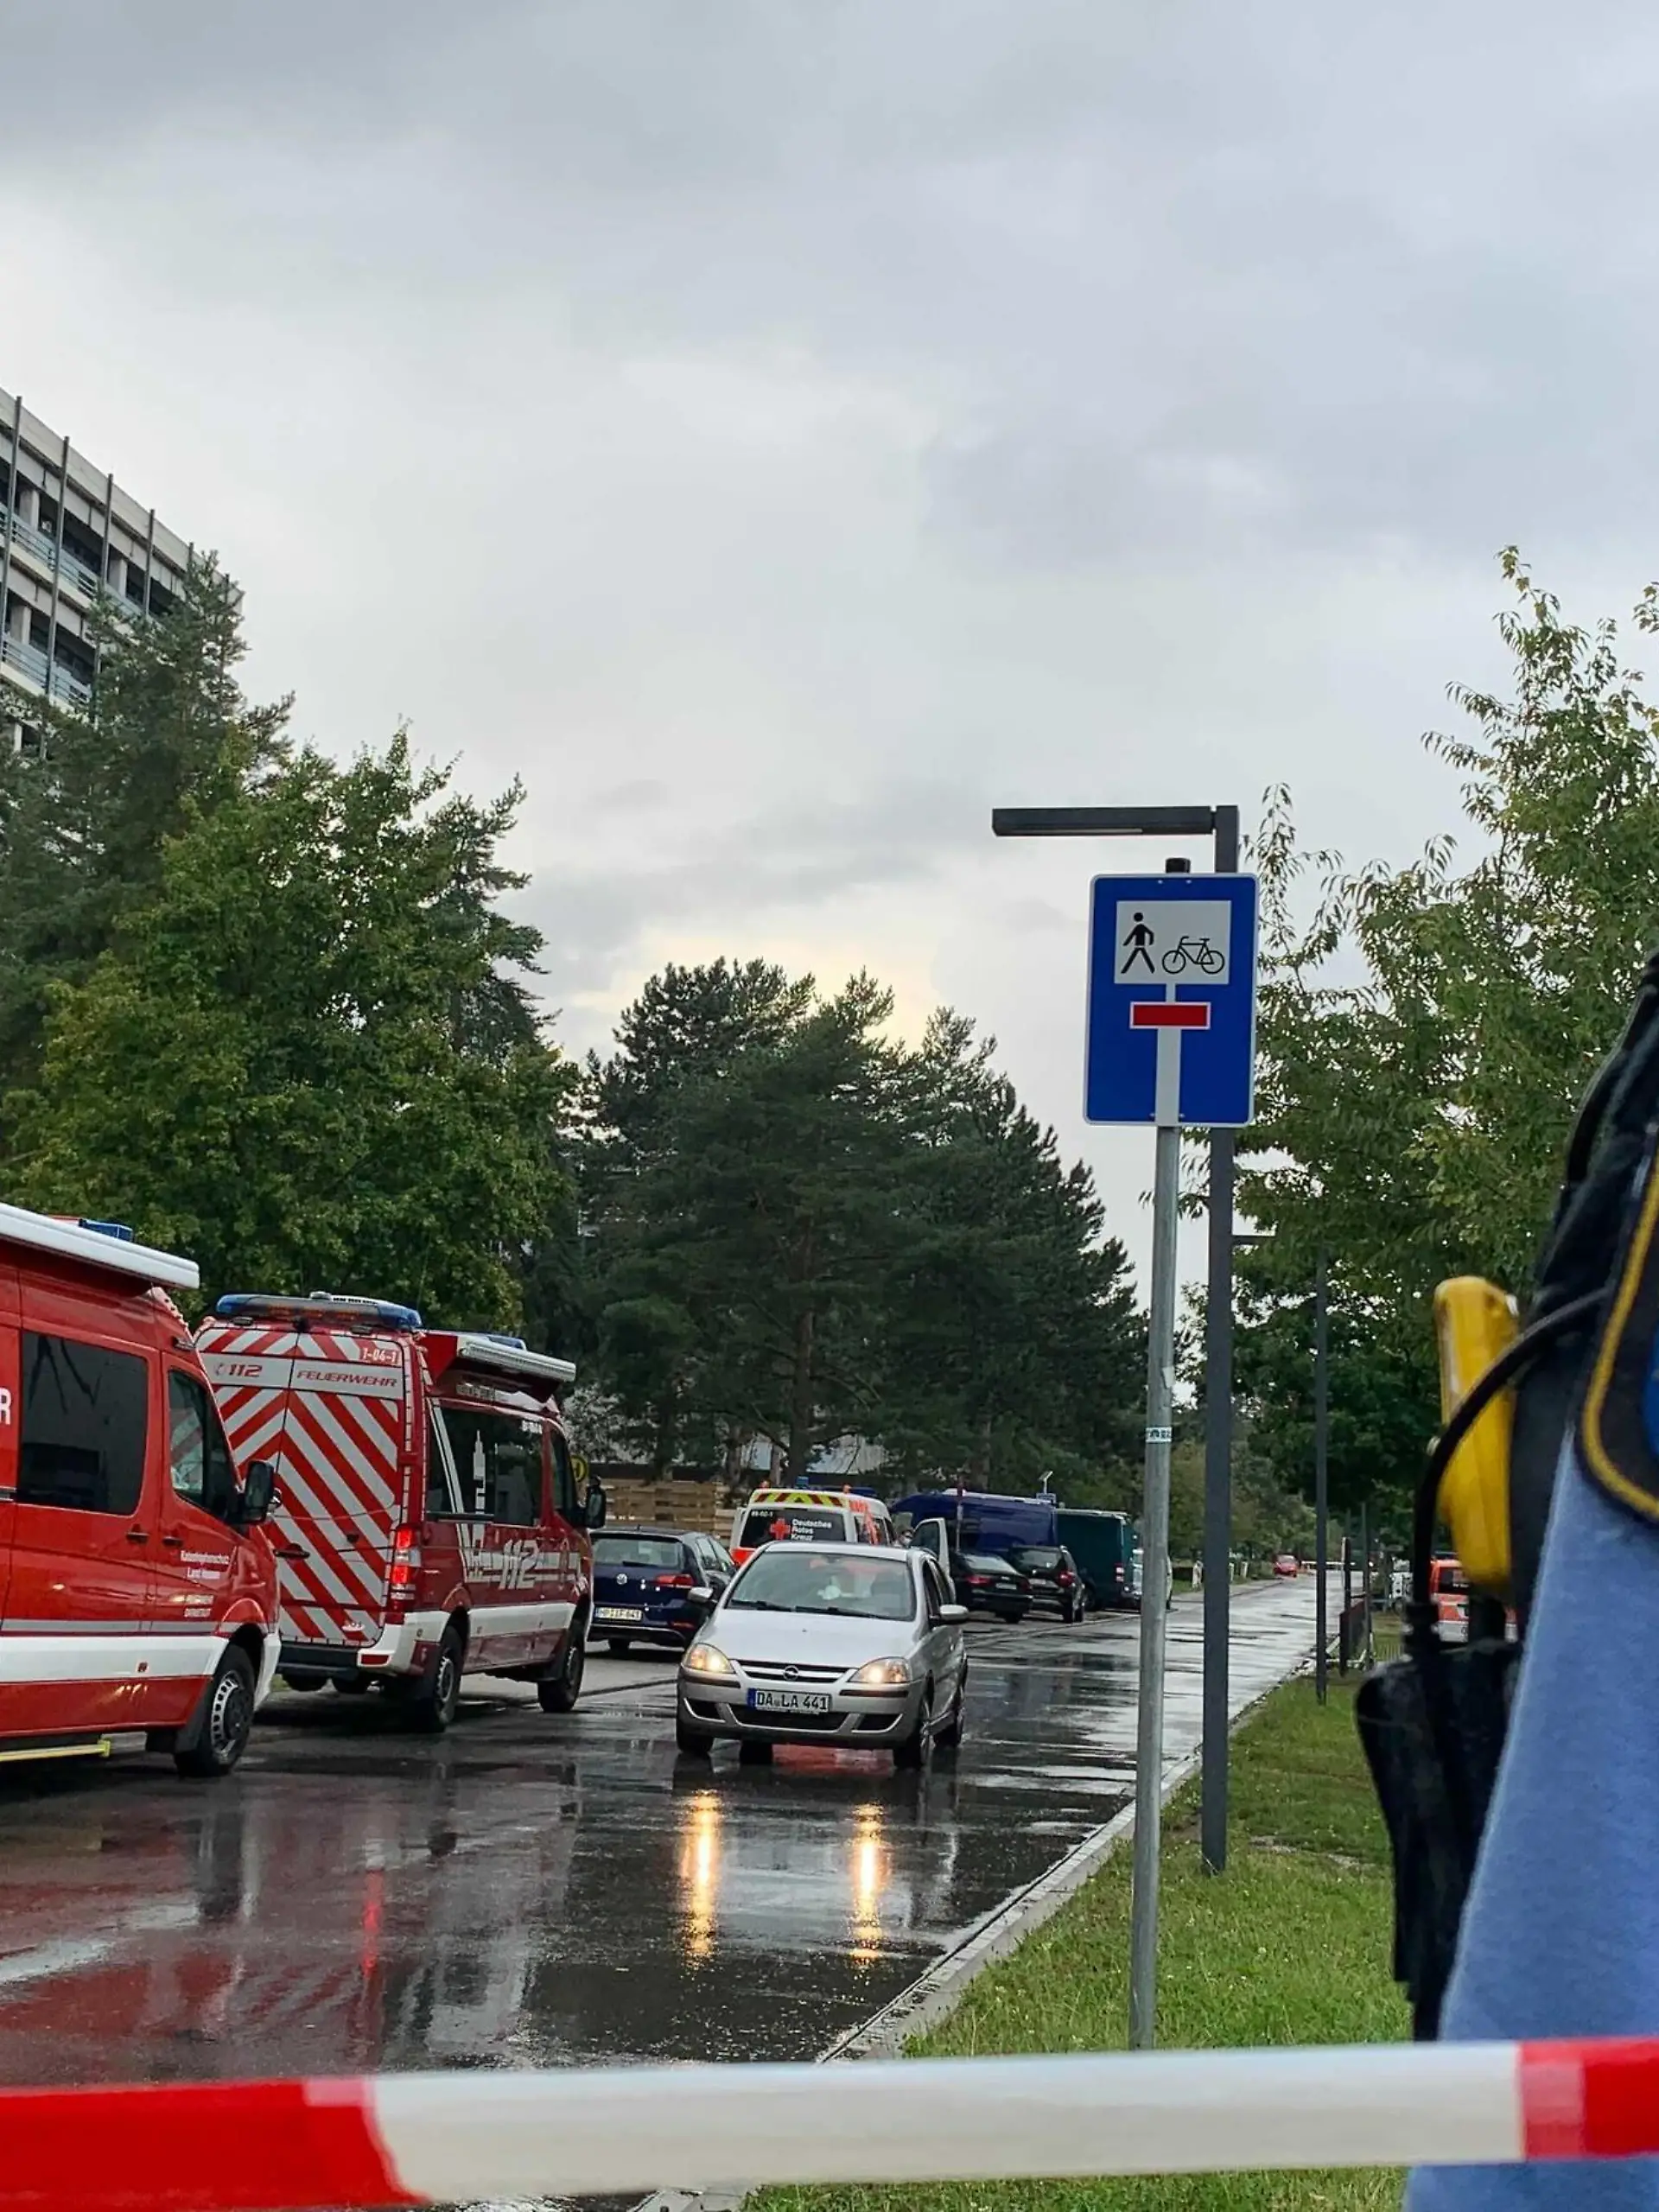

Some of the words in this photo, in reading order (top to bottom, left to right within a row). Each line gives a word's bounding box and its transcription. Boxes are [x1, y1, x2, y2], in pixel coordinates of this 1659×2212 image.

[363, 1347, 397, 1363] 1-06-1
[229, 1364, 263, 1377] 112
[296, 1370, 397, 1388] FEUERWEHR
[791, 1526, 813, 1535] Rotes
[792, 1518, 831, 1529] Deutsches
[498, 1539, 539, 1590] 112
[757, 1691, 772, 1707] DA
[781, 1694, 798, 1707] LA
[804, 1695, 827, 1710] 441
